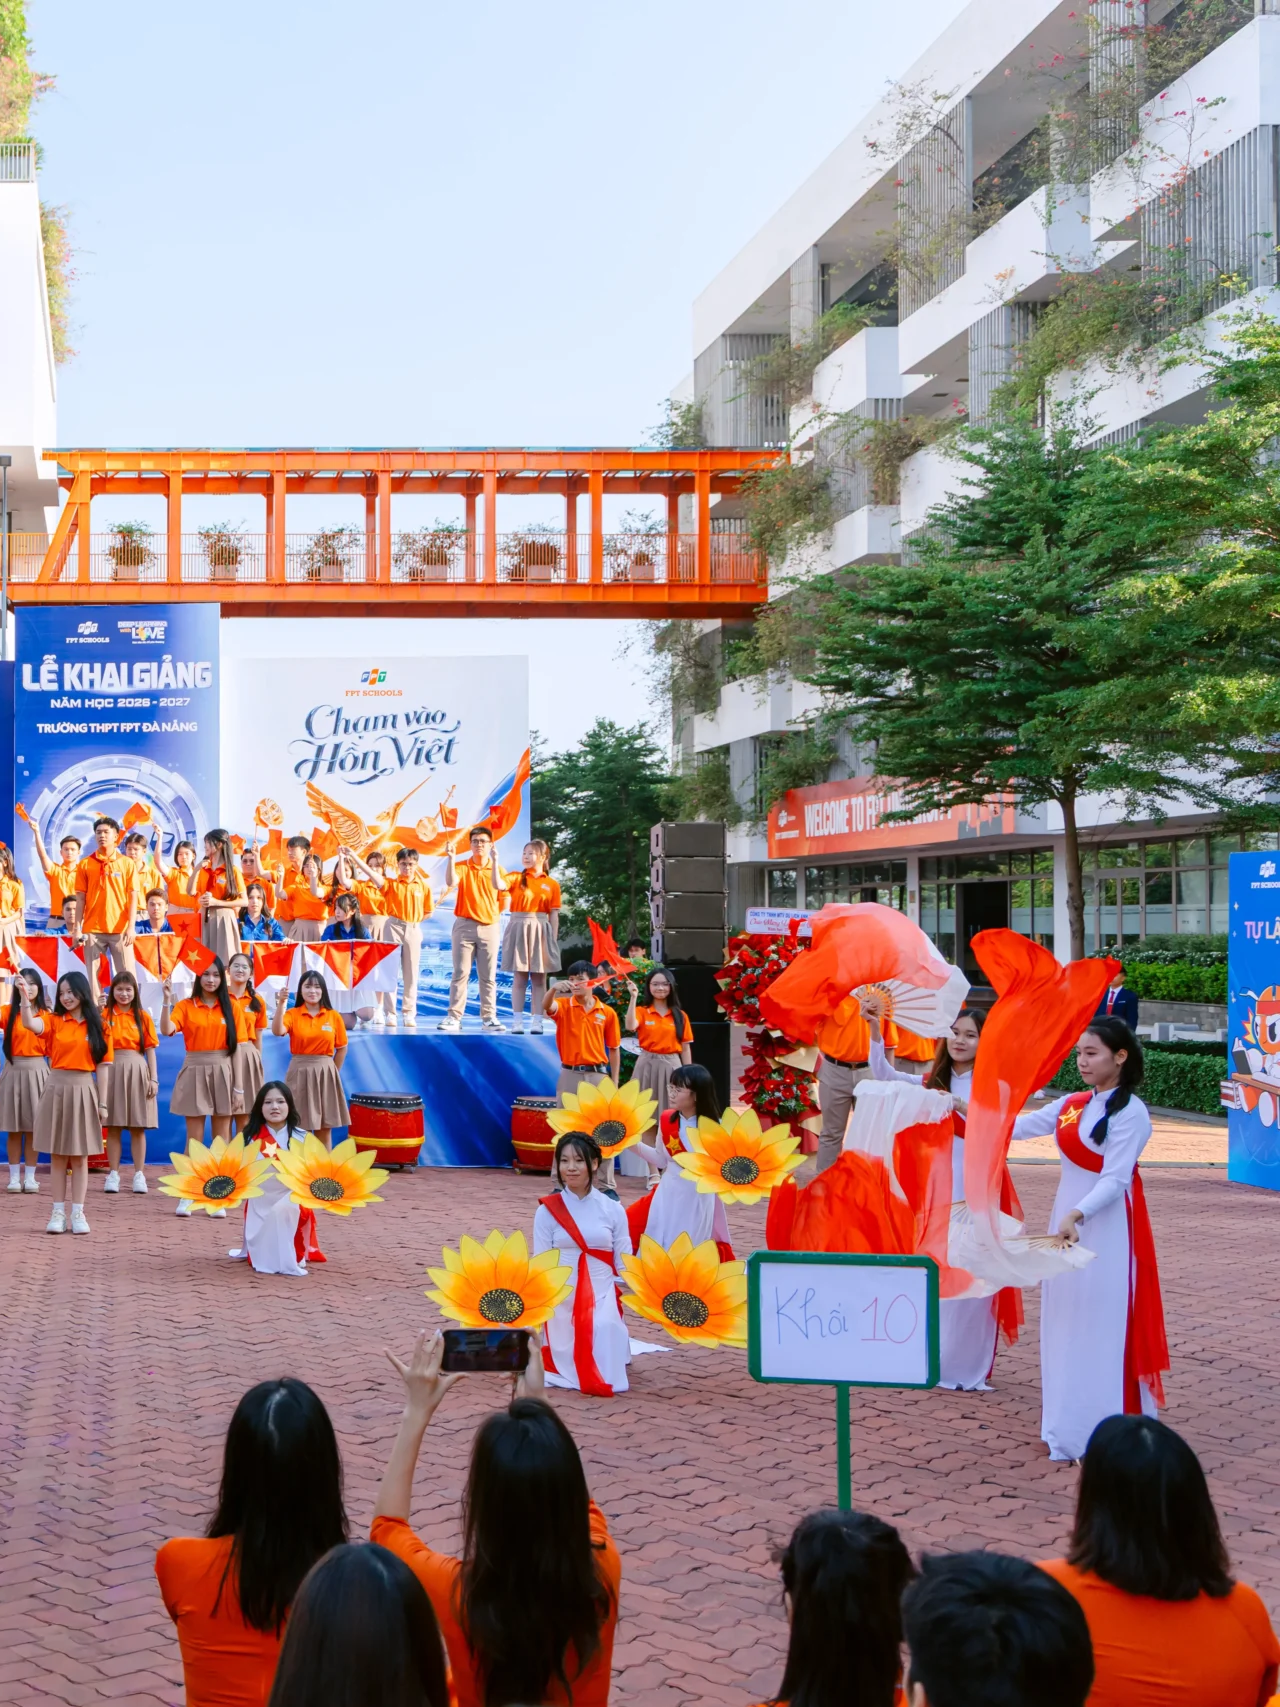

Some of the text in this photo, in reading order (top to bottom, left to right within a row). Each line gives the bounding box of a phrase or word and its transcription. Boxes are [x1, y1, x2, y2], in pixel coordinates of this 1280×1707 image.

[22, 654, 213, 692] LỄ KHAI GIẢNG
[360, 668, 387, 685] FPT
[50, 696, 82, 709] NĂM
[84, 698, 114, 710] HỌC
[117, 698, 151, 708] 2026
[159, 697, 191, 707] 2027
[36, 722, 88, 734] TRƯỜNG
[89, 723, 119, 733] THPT
[120, 722, 141, 733] FPT
[142, 720, 161, 732] ĐÀ
[305, 704, 452, 739] Chạm vào
[289, 735, 460, 785] Hồn Việt
[804, 798, 849, 838] WELCOME
[851, 796, 864, 833] TO
[1244, 921, 1264, 944] TỰ
[861, 1294, 918, 1344] 10
